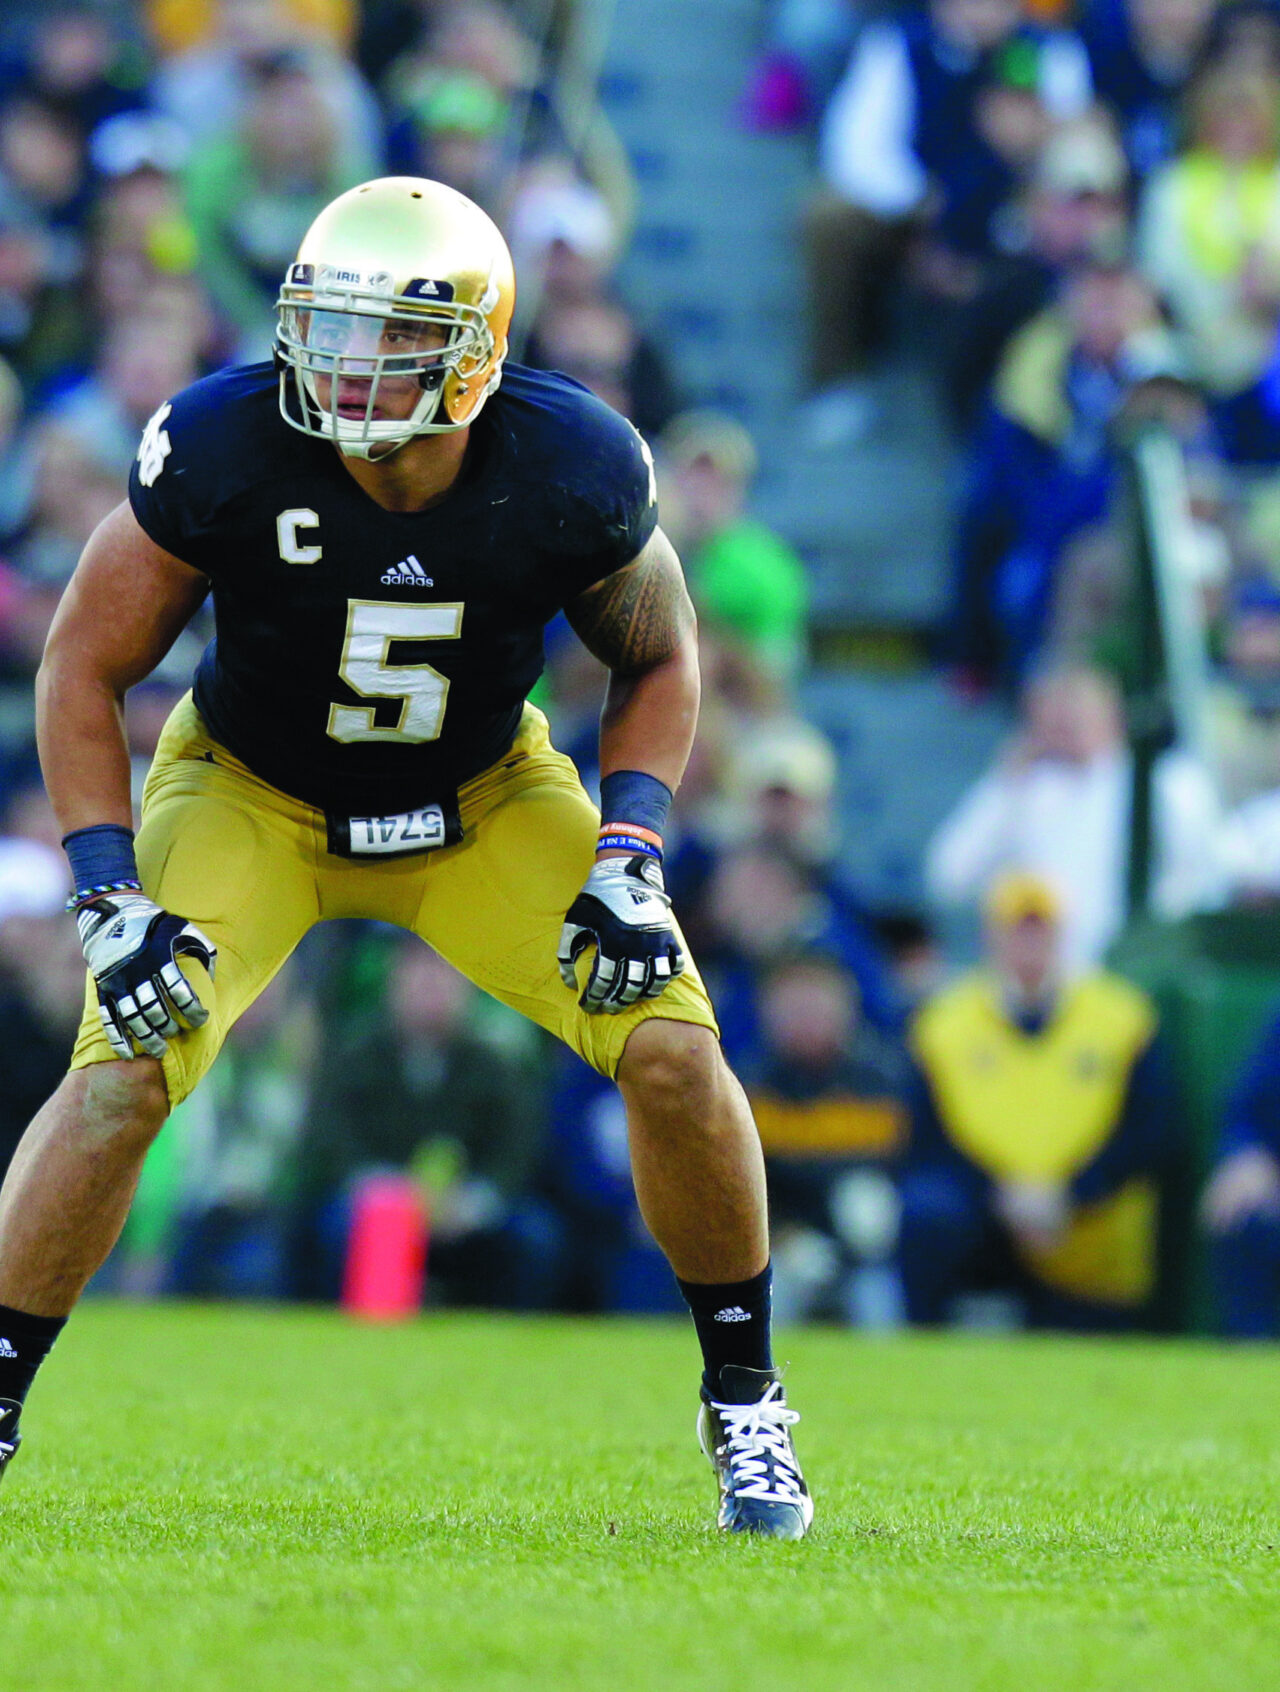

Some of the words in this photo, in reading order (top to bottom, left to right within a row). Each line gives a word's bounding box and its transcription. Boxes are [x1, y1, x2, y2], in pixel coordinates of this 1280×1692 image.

[336, 270, 365, 285] IRIS
[276, 507, 323, 565] C
[380, 572, 434, 588] adidas
[326, 598, 465, 745] 5
[611, 822, 644, 836] Johnny
[714, 1312, 752, 1323] adidas
